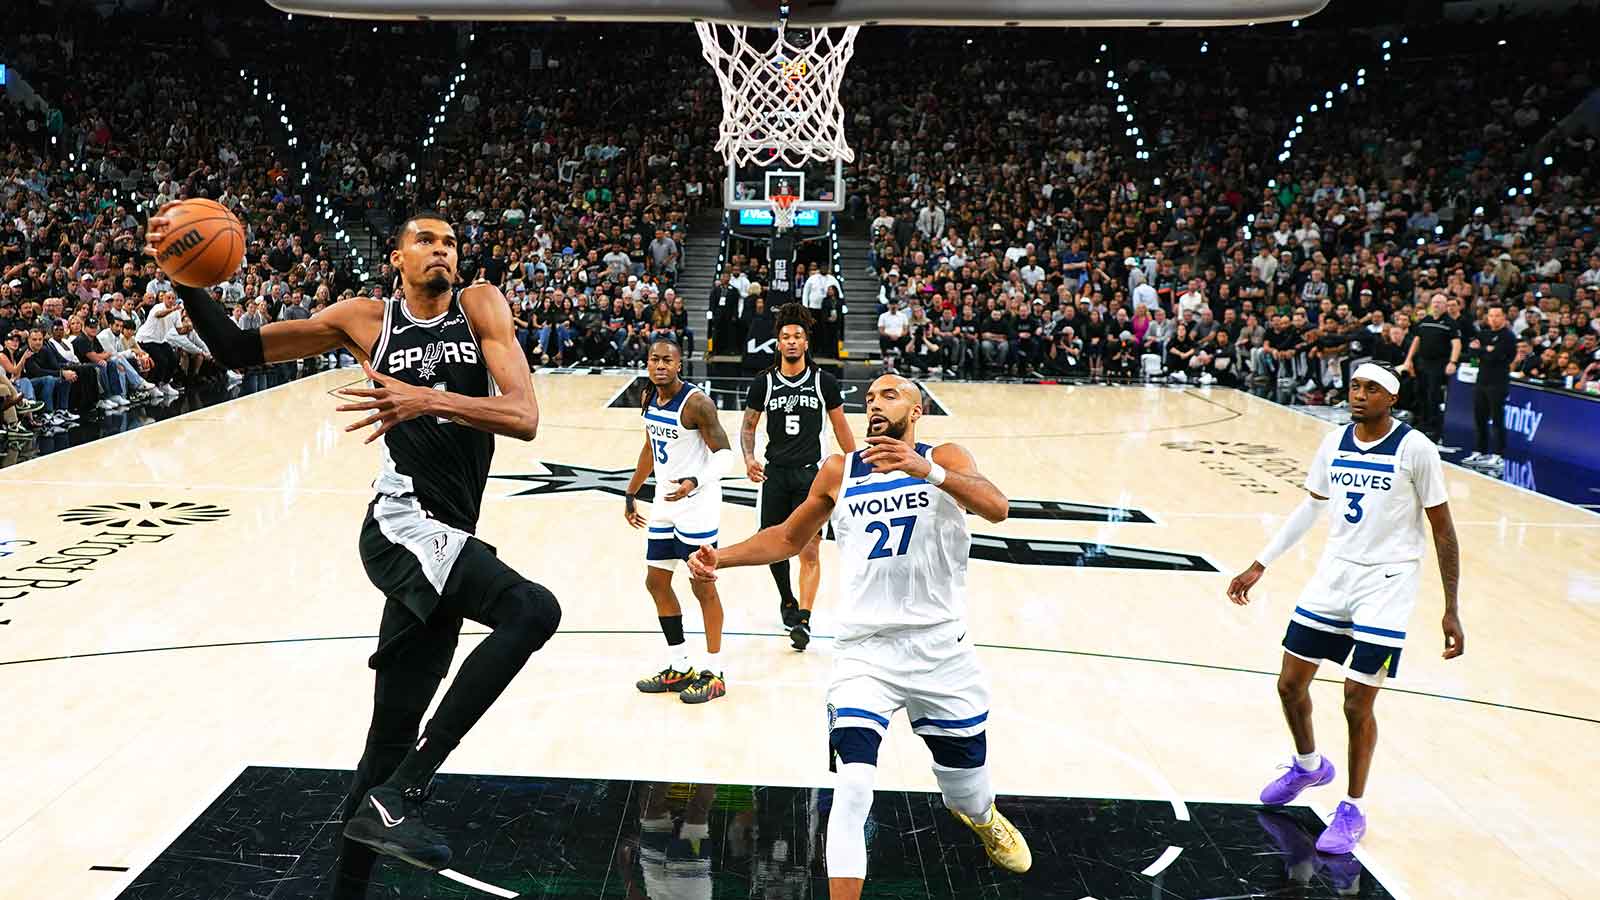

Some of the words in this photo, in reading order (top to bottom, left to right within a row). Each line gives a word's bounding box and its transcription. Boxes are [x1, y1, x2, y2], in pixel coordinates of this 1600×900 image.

[388, 341, 478, 379] SPURS
[769, 395, 819, 412] SPURS
[1504, 395, 1543, 441] inity
[785, 415, 800, 435] 5
[652, 438, 668, 464] 13
[1330, 472, 1392, 490] WOLVES
[849, 491, 930, 517] WOLVES
[1344, 491, 1365, 524] 3
[16, 531, 176, 573] Frost
[865, 515, 917, 560] 27
